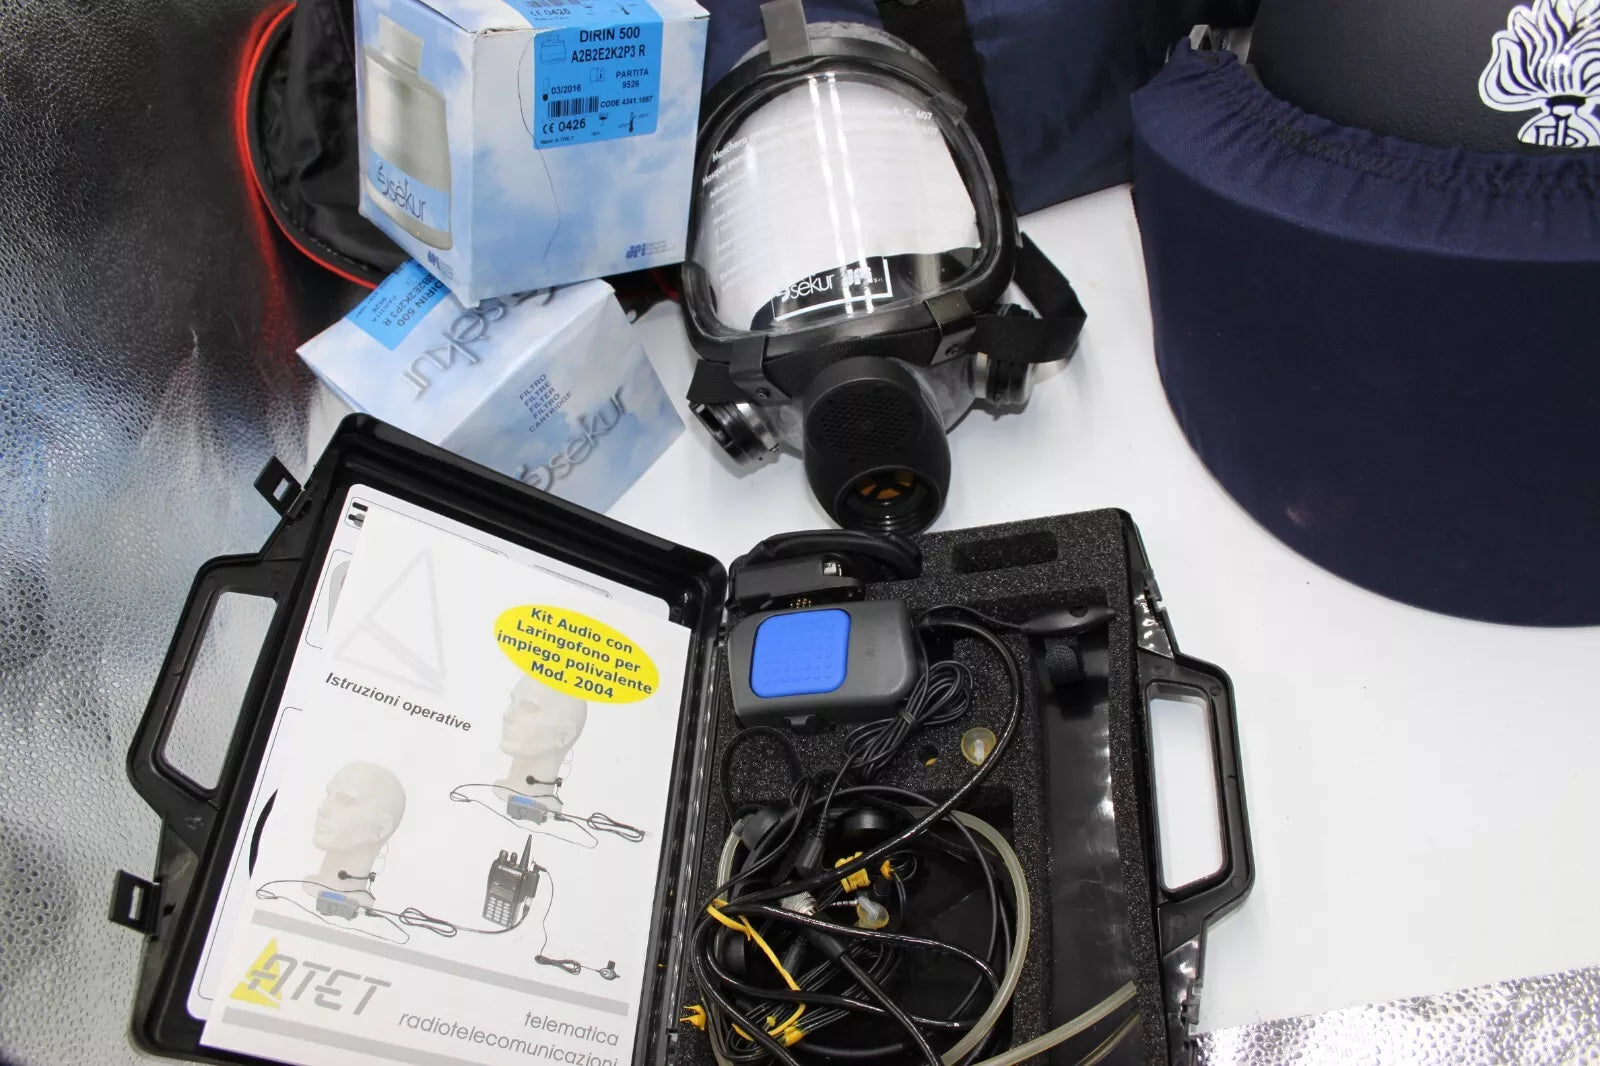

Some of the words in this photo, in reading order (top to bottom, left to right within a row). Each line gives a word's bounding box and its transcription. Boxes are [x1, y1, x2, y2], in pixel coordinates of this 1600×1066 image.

[579, 29, 615, 43] DIRIN
[619, 26, 640, 40] 500
[571, 46, 635, 63] A2B2E2K2P3
[638, 44, 646, 57] R
[616, 68, 649, 79] PARTITA
[551, 84, 582, 95] 03/2016
[600, 99, 620, 108] CODE
[916, 110, 932, 121] 607
[558, 118, 586, 132] 0426
[520, 374, 547, 401] FILTRO
[524, 381, 552, 407] FILTRE
[529, 387, 556, 413] FILTER
[528, 391, 573, 433] CARTRIDGE
[533, 393, 560, 419] FILTRO
[531, 608, 553, 625] Kit
[557, 618, 601, 643] Audio
[606, 637, 633, 654] con
[516, 620, 610, 663] Laringofono
[614, 657, 641, 673] per
[497, 630, 561, 663] impiego
[565, 658, 652, 695] polivalente
[531, 661, 568, 684] Mod.
[574, 676, 614, 699] 2004
[325, 672, 401, 707] Istruzioni
[402, 701, 472, 731] operative
[247, 953, 392, 1016] ATET
[524, 1011, 619, 1046] telematica
